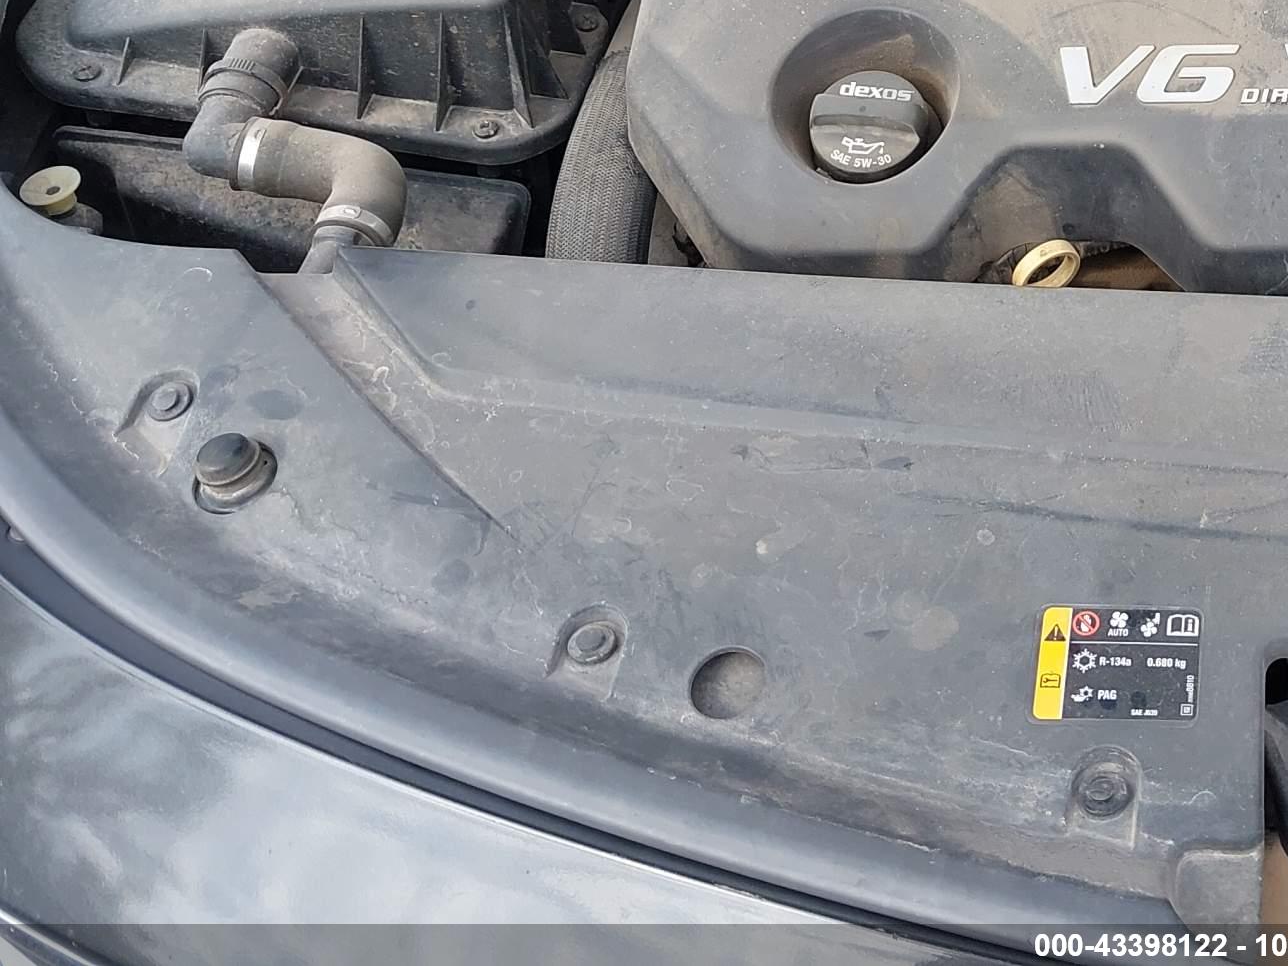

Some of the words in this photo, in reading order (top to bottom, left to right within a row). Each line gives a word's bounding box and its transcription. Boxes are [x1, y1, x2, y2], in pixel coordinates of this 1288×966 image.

[1060, 44, 1240, 105] V6
[839, 81, 914, 101] dexos
[831, 150, 851, 166] SAE
[853, 154, 892, 168] 5W-30
[1107, 628, 1129, 637] AUTO
[1099, 656, 1132, 667] R-134a
[1175, 658, 1187, 670] kg
[1097, 689, 1118, 700] PAG
